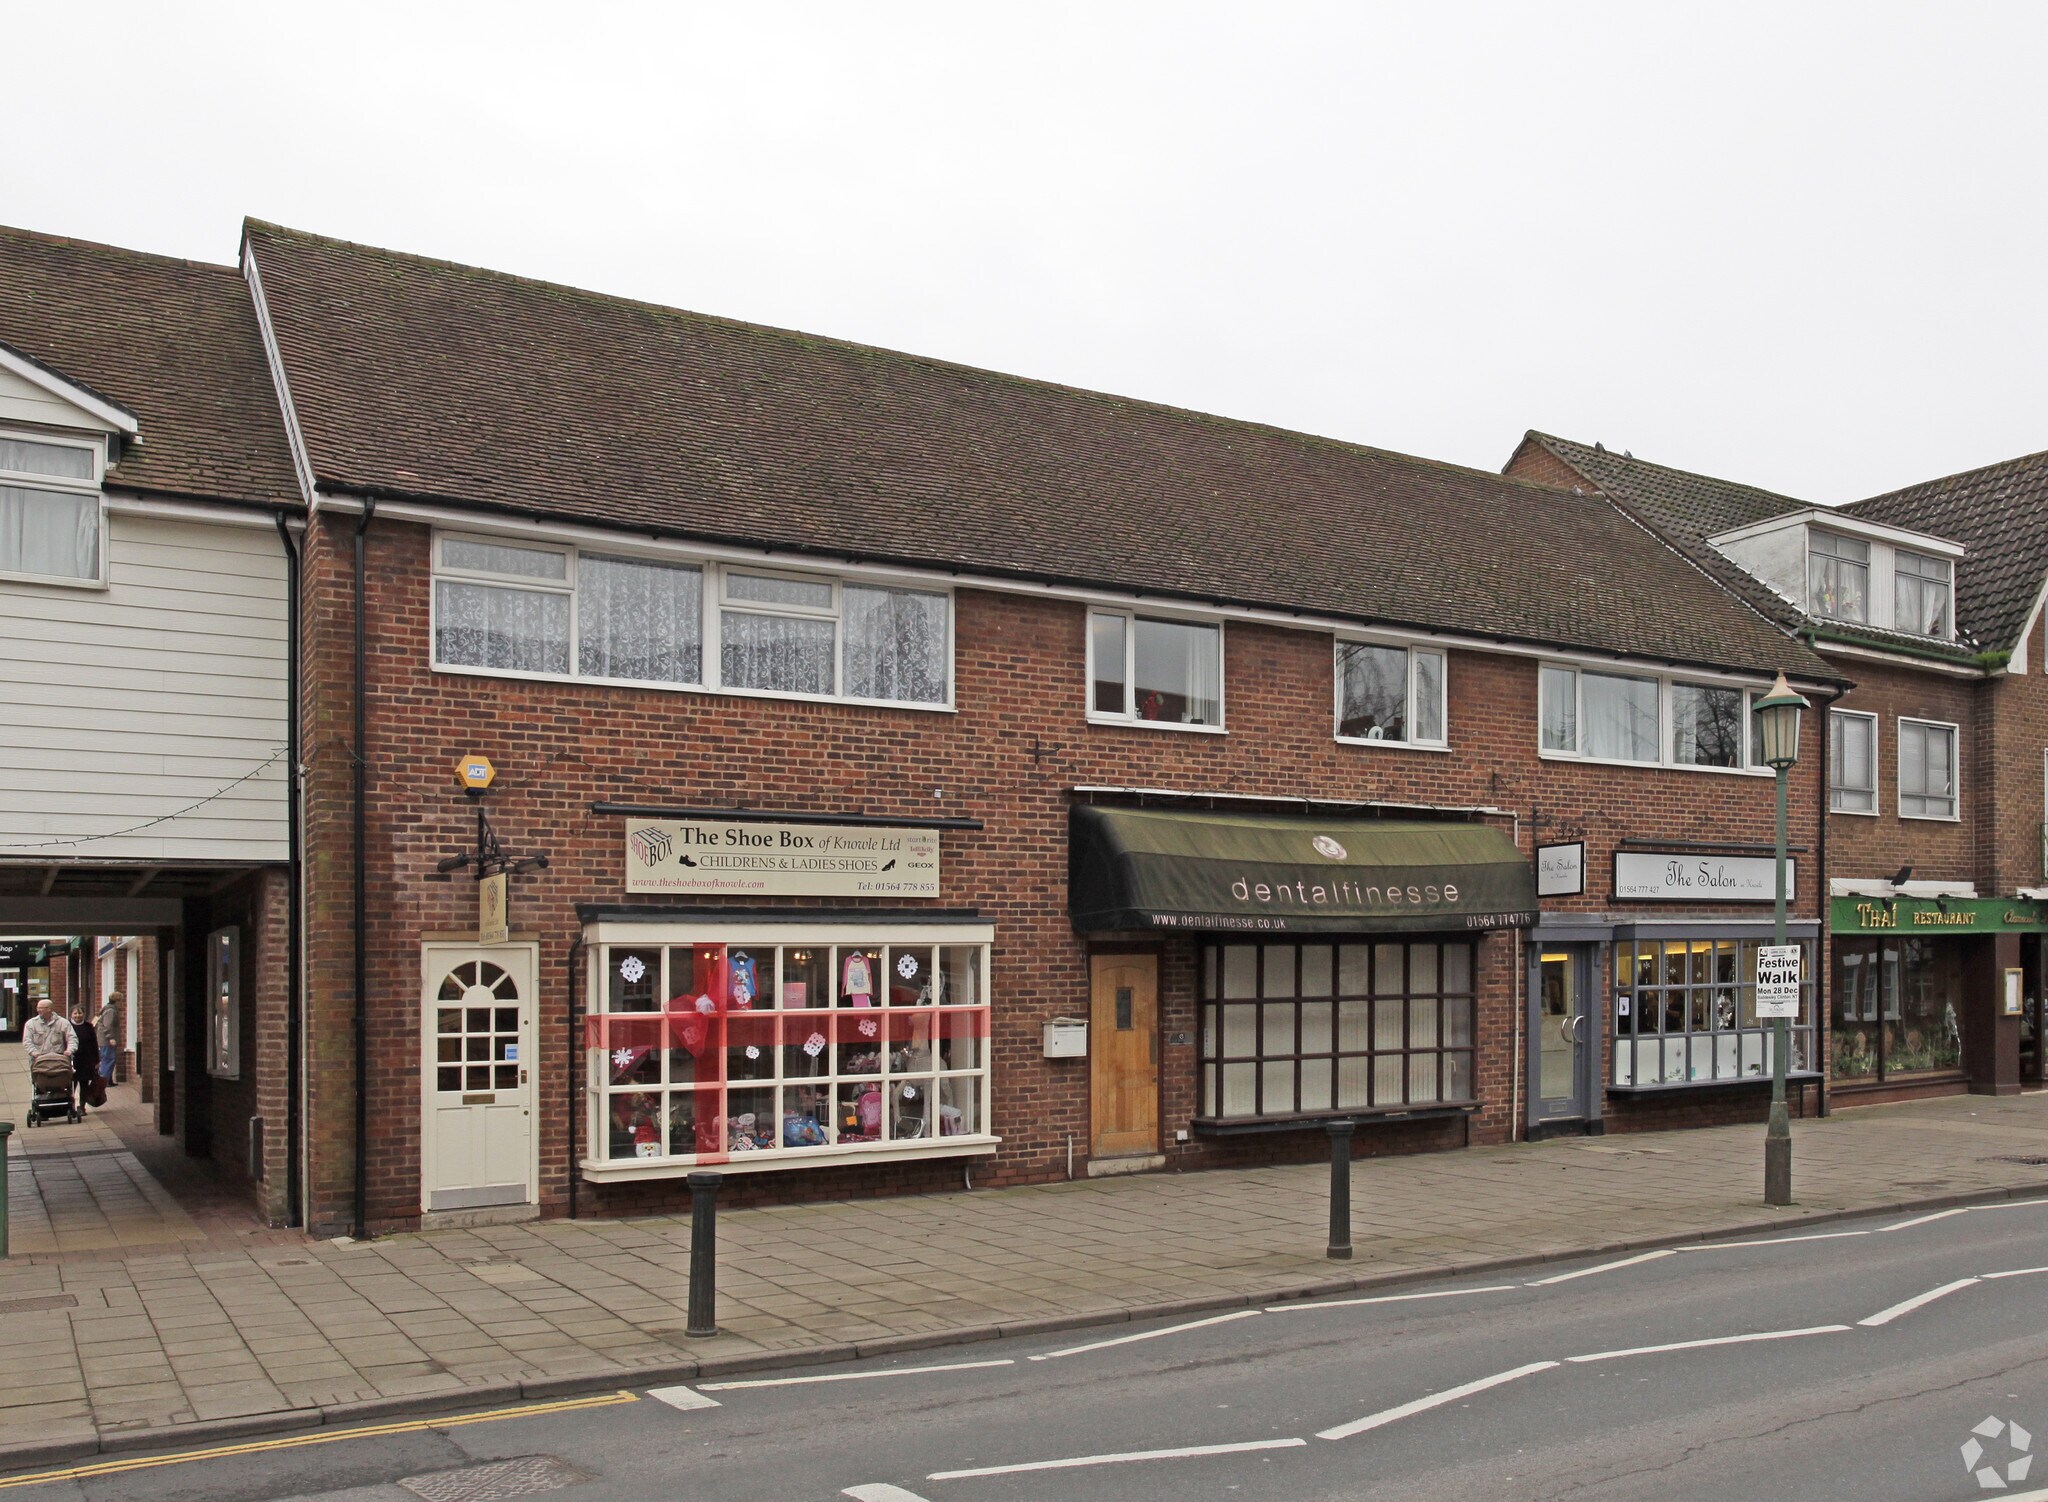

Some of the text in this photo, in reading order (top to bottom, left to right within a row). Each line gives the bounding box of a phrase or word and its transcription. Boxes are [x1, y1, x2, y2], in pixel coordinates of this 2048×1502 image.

[468, 768, 487, 777] ADT
[632, 827, 672, 845] THE
[680, 827, 901, 853] The Shoe Box of Knowle Ltd
[630, 835, 672, 867] SHOE BOX
[700, 855, 878, 871] CHILDRENS & LADIES SHOES
[1541, 858, 1578, 872] The Salon
[1665, 860, 1738, 888] The Salon
[632, 878, 765, 890] www.theshoeboxofknowle.com
[857, 882, 935, 892] Tel: 01564 778 855
[1231, 876, 1459, 904] dentalfinesse
[1620, 886, 1637, 894] 01564
[1152, 914, 1286, 929] www.dentalfinesse.co.uk
[1466, 915, 1495, 927] 01564
[1913, 911, 1976, 925] RESTAURANT
[1759, 957, 1799, 968] Festive
[1758, 970, 1798, 984] Walk
